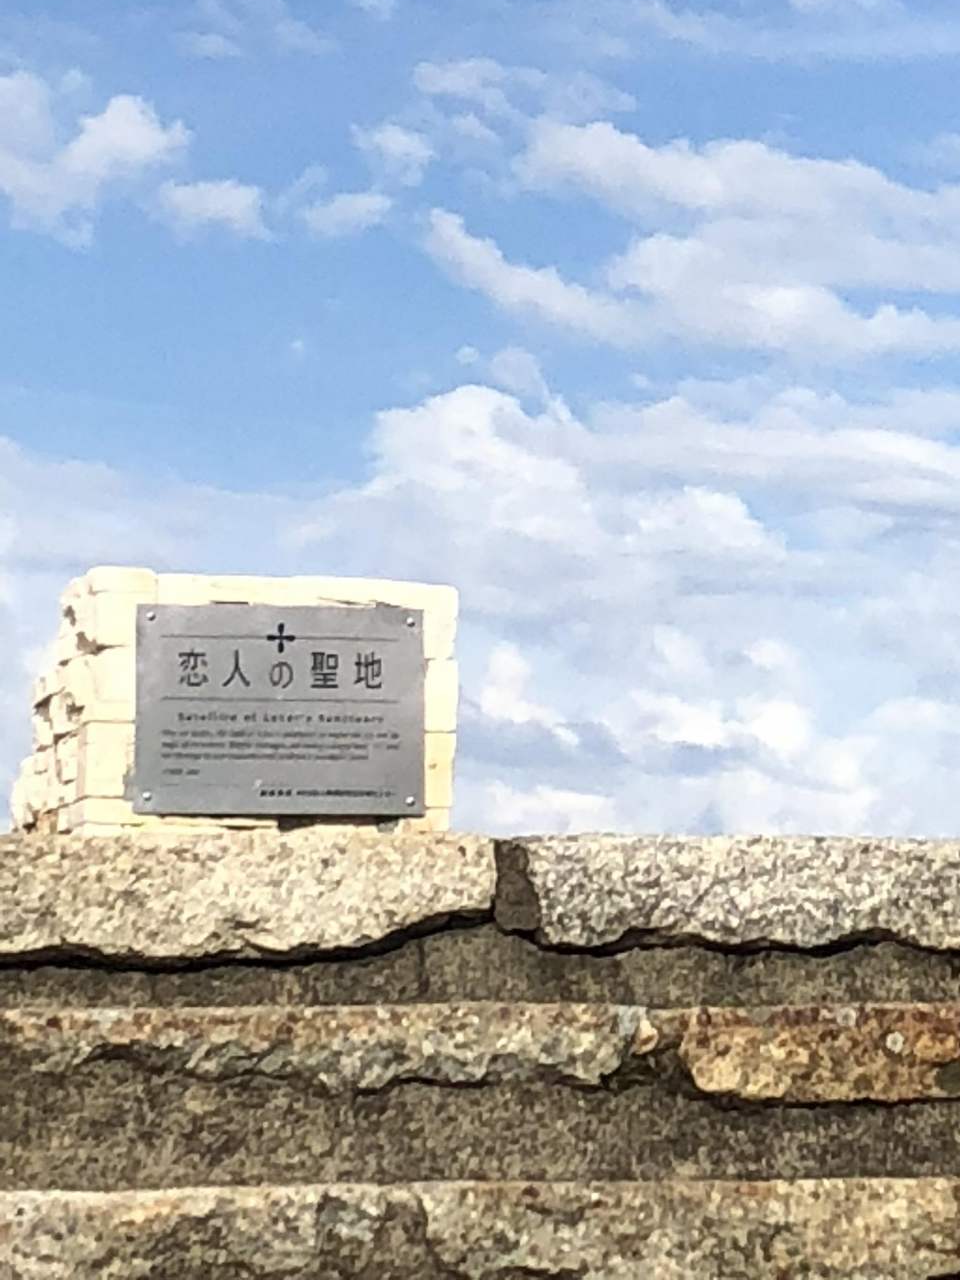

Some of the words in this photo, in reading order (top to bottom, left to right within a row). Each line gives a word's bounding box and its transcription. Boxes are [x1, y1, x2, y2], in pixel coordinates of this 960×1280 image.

[177, 648, 384, 690] 恋人の聖地
